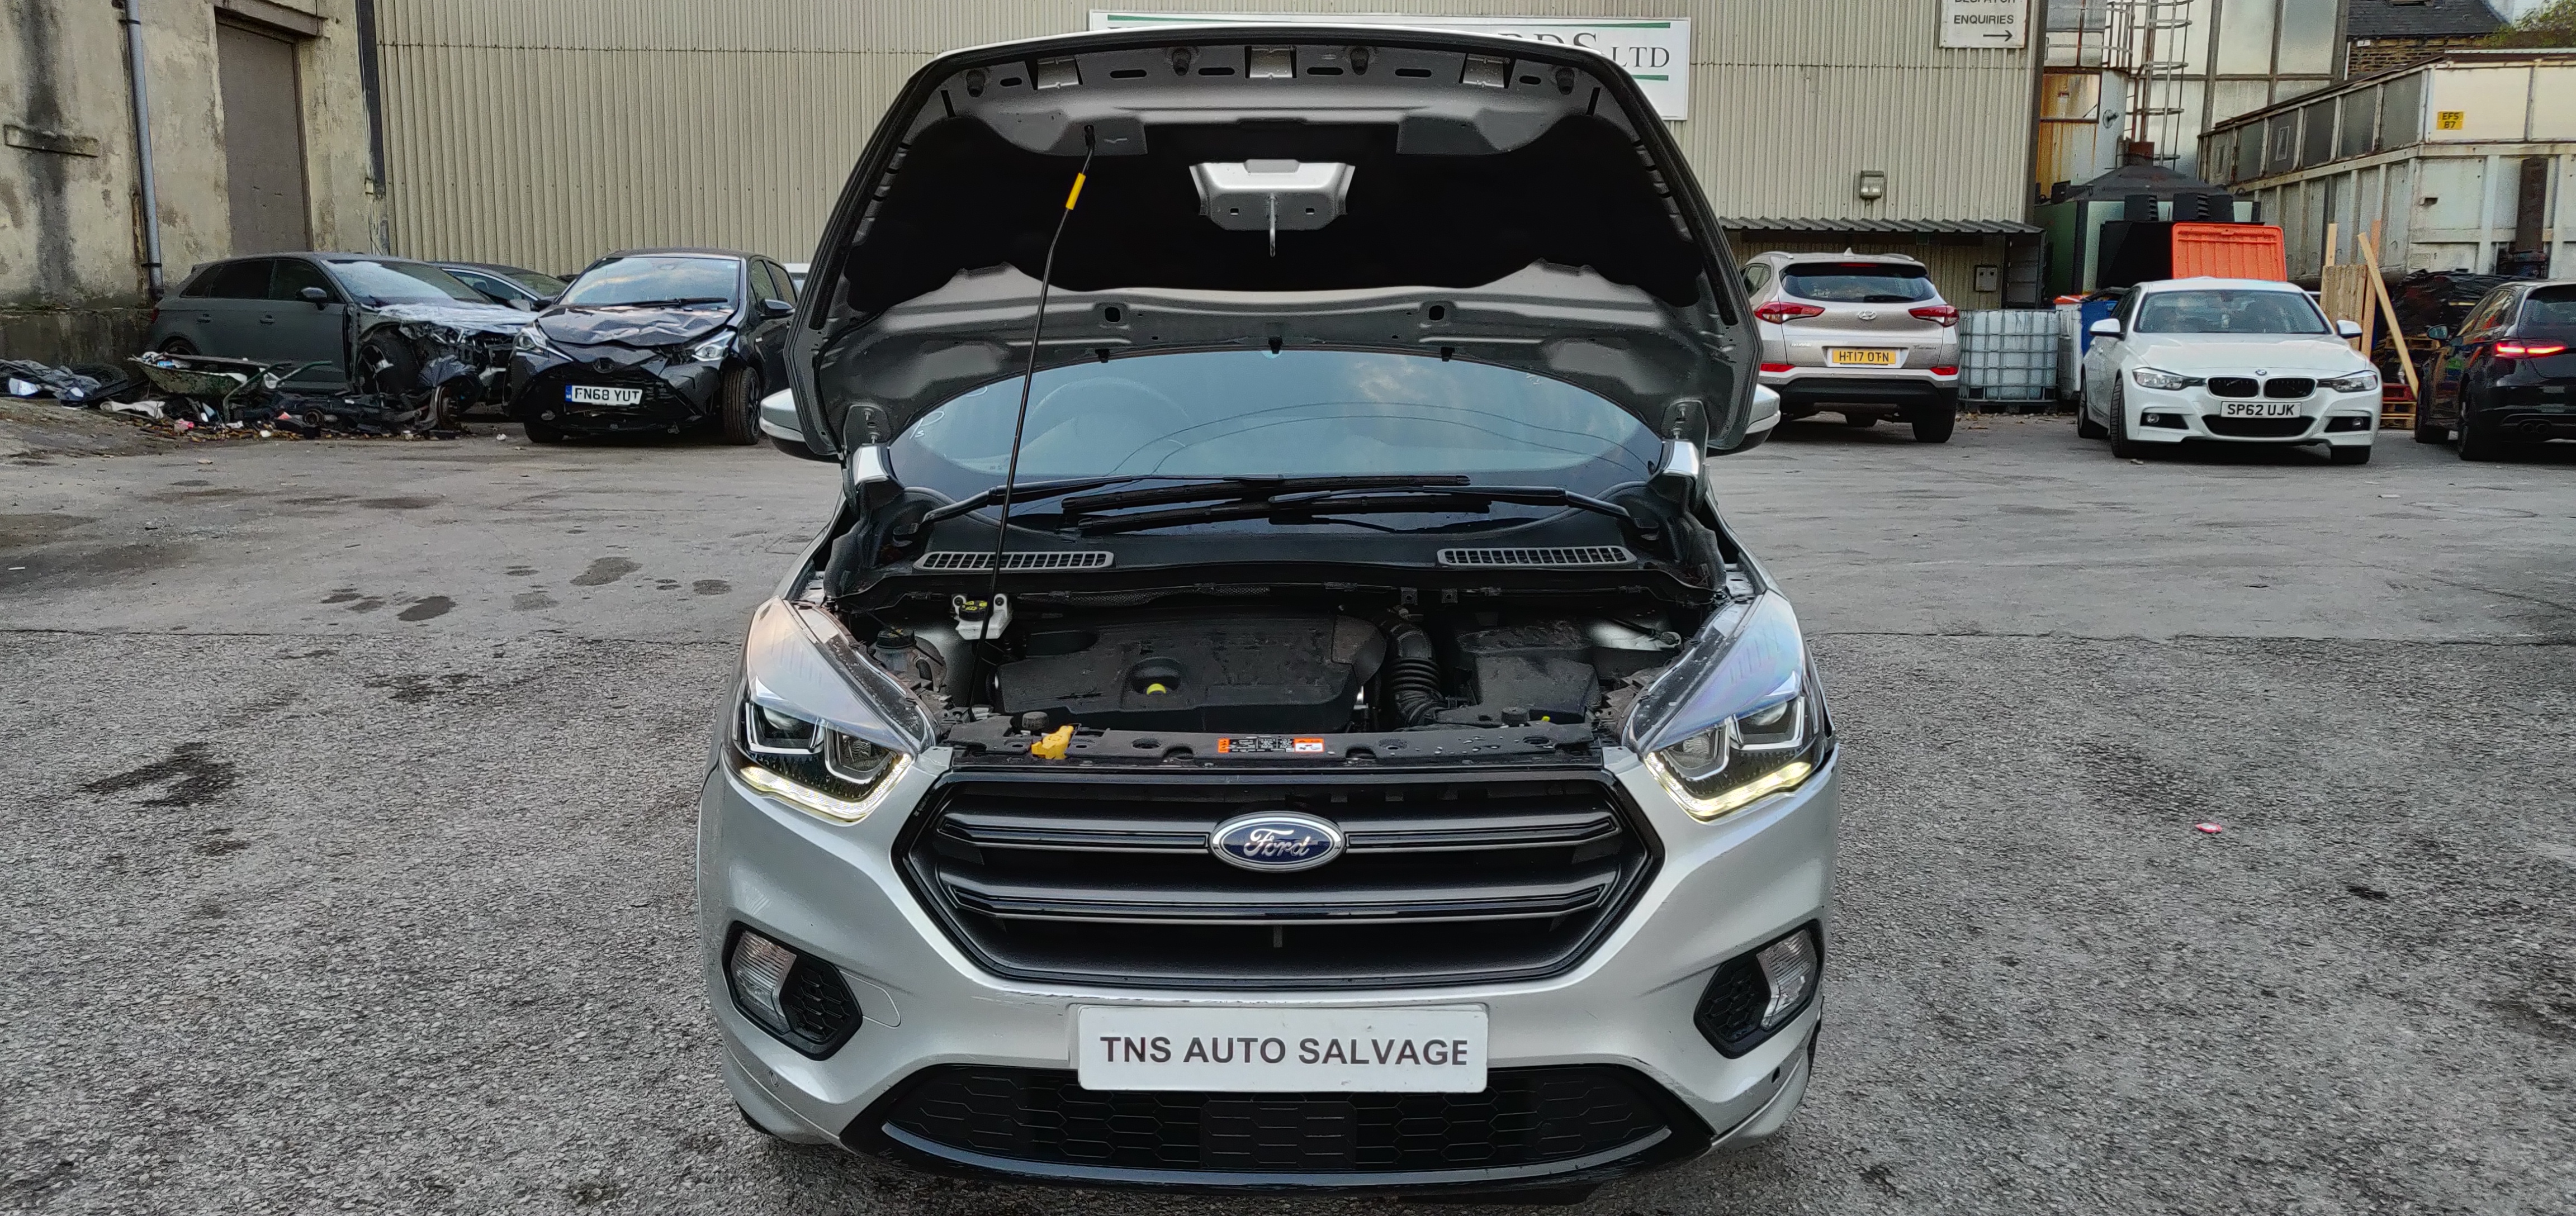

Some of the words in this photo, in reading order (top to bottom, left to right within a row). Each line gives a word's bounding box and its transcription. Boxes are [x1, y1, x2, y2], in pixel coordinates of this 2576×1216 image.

[1953, 15, 2014, 25] ENQUIRIES
[1610, 46, 1670, 68] LTD
[1839, 351, 1864, 362] HT17
[575, 387, 610, 401] FN68
[614, 390, 640, 402] YUT
[2227, 403, 2264, 416] SP62
[2267, 405, 2295, 416] UJK
[1243, 828, 1311, 857] Ford
[1100, 1036, 1171, 1063] TNS
[1183, 1037, 1286, 1063] AUTO
[1298, 1038, 1468, 1065] SALVAGE
